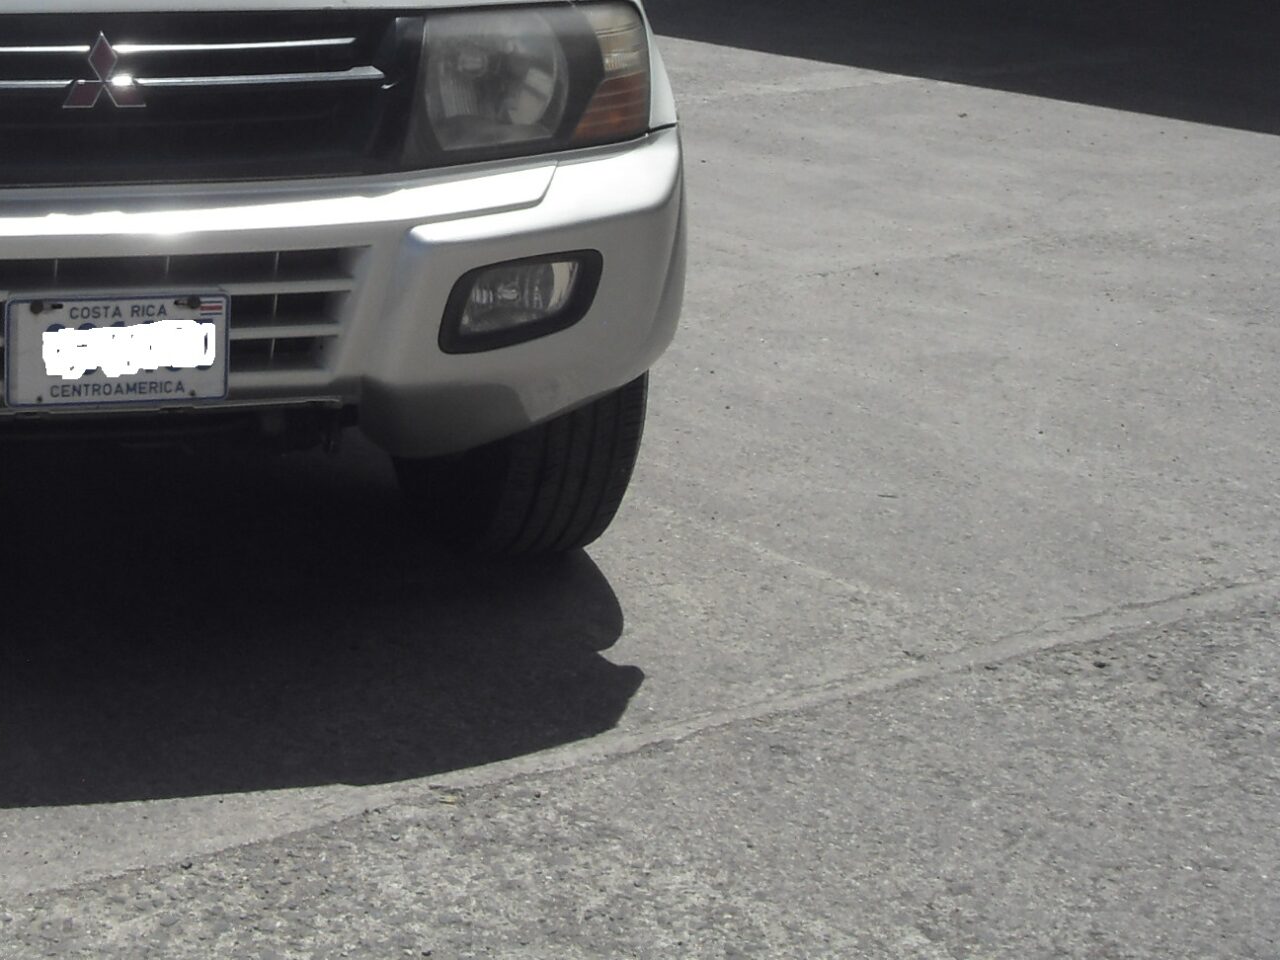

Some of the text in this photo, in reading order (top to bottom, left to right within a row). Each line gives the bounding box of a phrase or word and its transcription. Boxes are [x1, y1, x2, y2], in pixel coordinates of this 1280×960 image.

[70, 304, 168, 320] COSTA RICA
[50, 380, 185, 398] CENTROAMERICA
